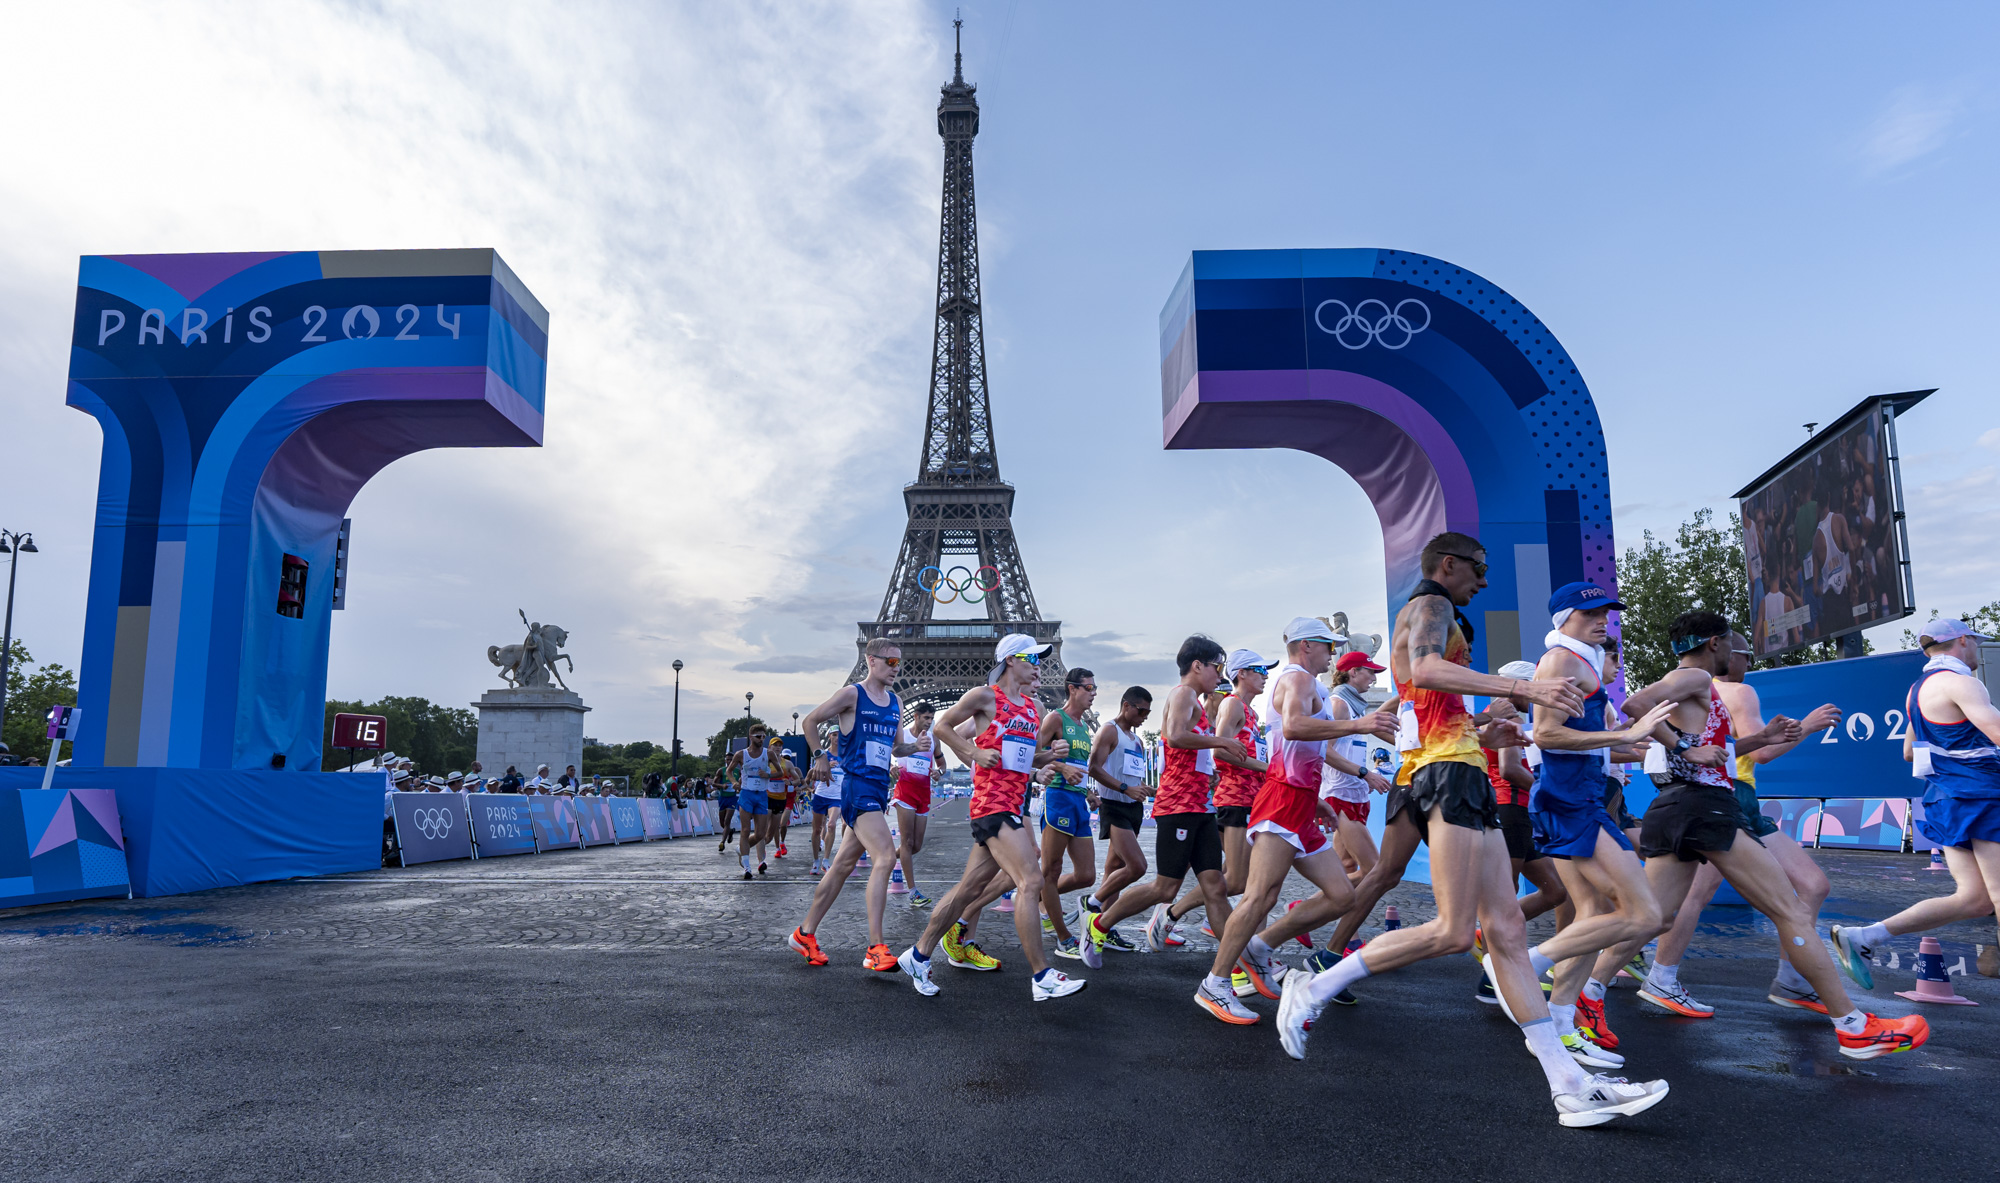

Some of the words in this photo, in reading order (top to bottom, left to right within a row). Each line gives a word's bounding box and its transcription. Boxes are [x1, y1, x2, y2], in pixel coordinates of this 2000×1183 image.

[299, 303, 461, 343] 2024
[1580, 587, 1607, 599] FRAN
[356, 720, 379, 742] 16
[1004, 718, 1037, 733] JAPAN
[1820, 708, 1906, 744] 202
[878, 746, 886, 756] 36
[1018, 746, 1028, 757] 57
[490, 824, 521, 839] 2024
